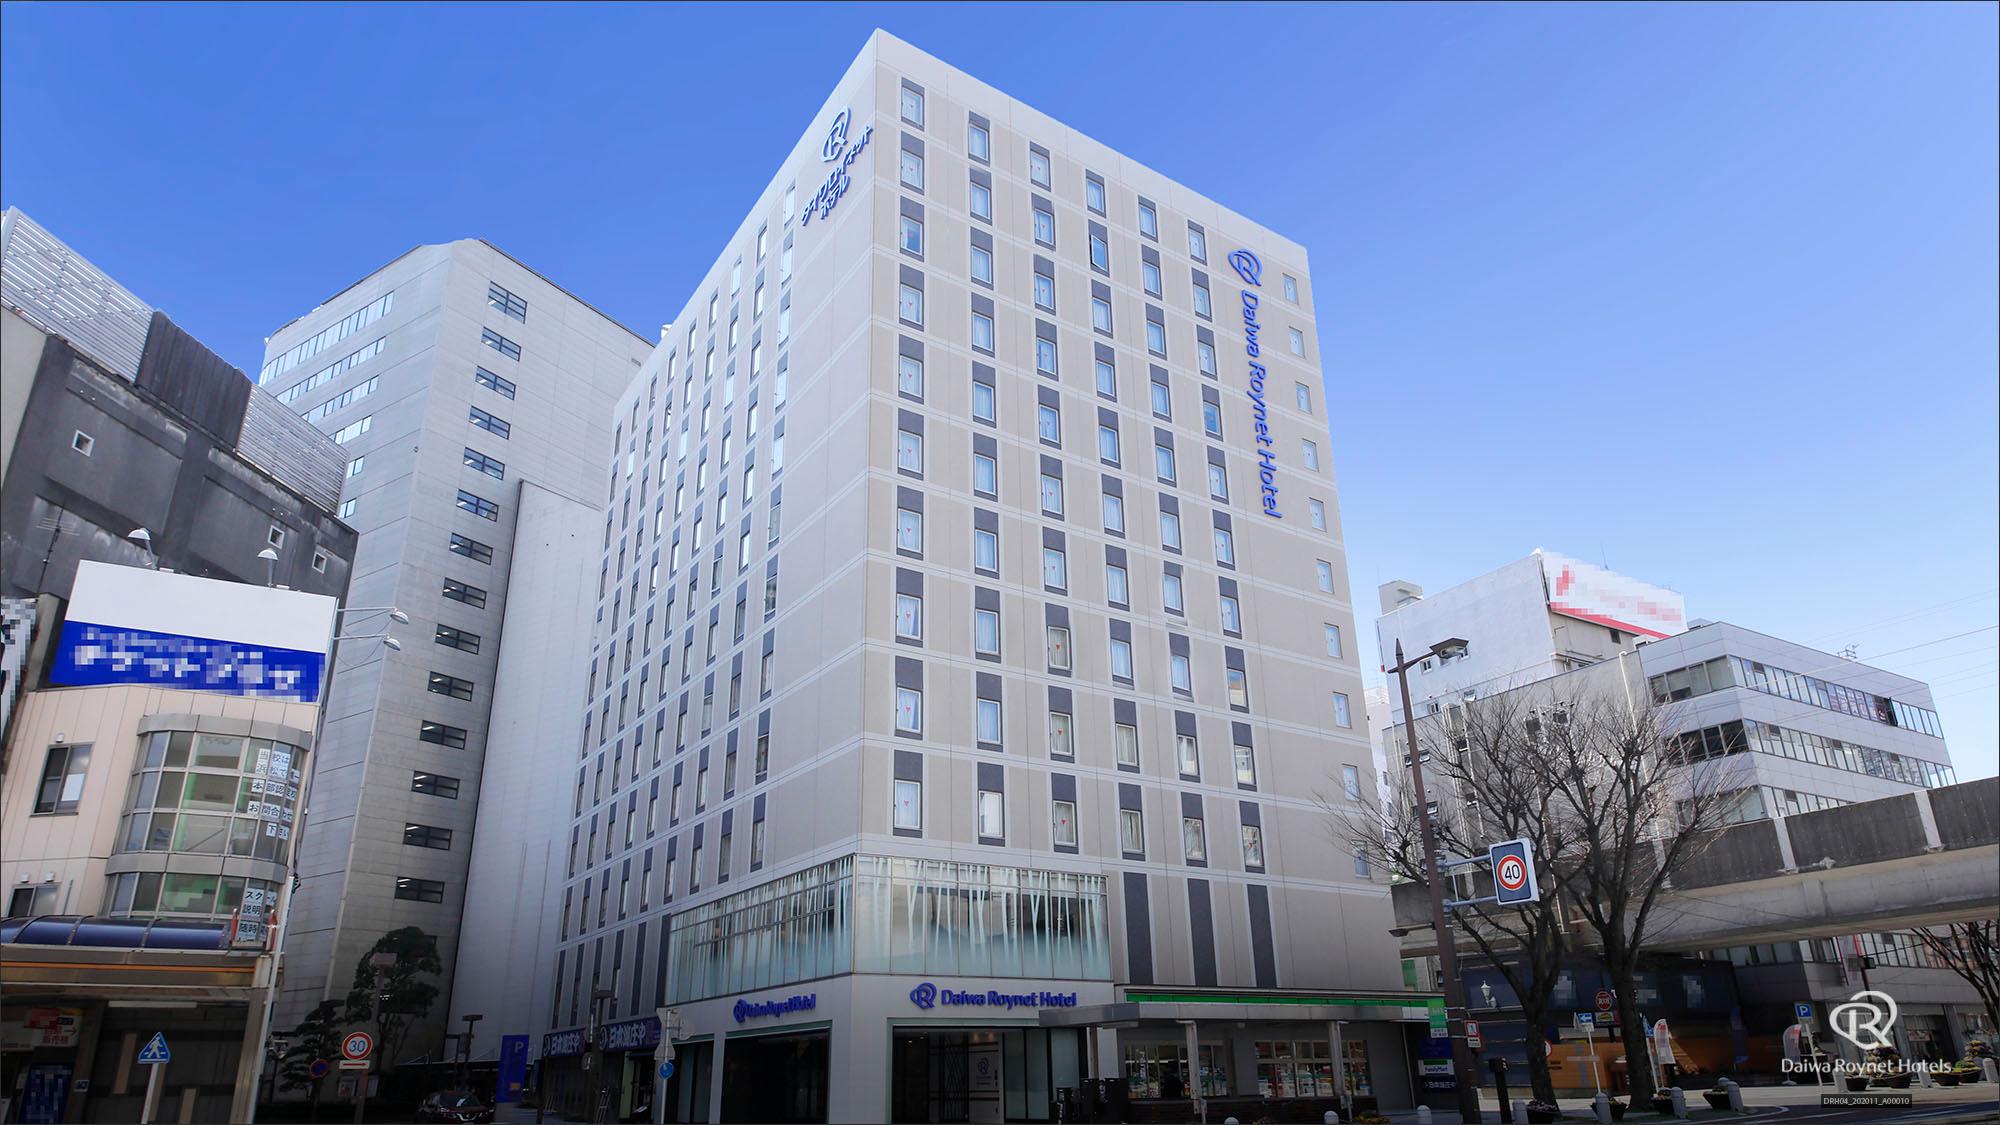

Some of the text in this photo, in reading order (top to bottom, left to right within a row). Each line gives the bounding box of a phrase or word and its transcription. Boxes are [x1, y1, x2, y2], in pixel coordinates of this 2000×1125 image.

[1242, 289, 1283, 519] Daiwa Roynet Hotel
[1505, 864, 1520, 880] 40
[941, 989, 1077, 1010] Daiwa Roynet Hotel
[1800, 1004, 1809, 1017] P
[349, 1040, 366, 1053] 30
[514, 1041, 525, 1053] P
